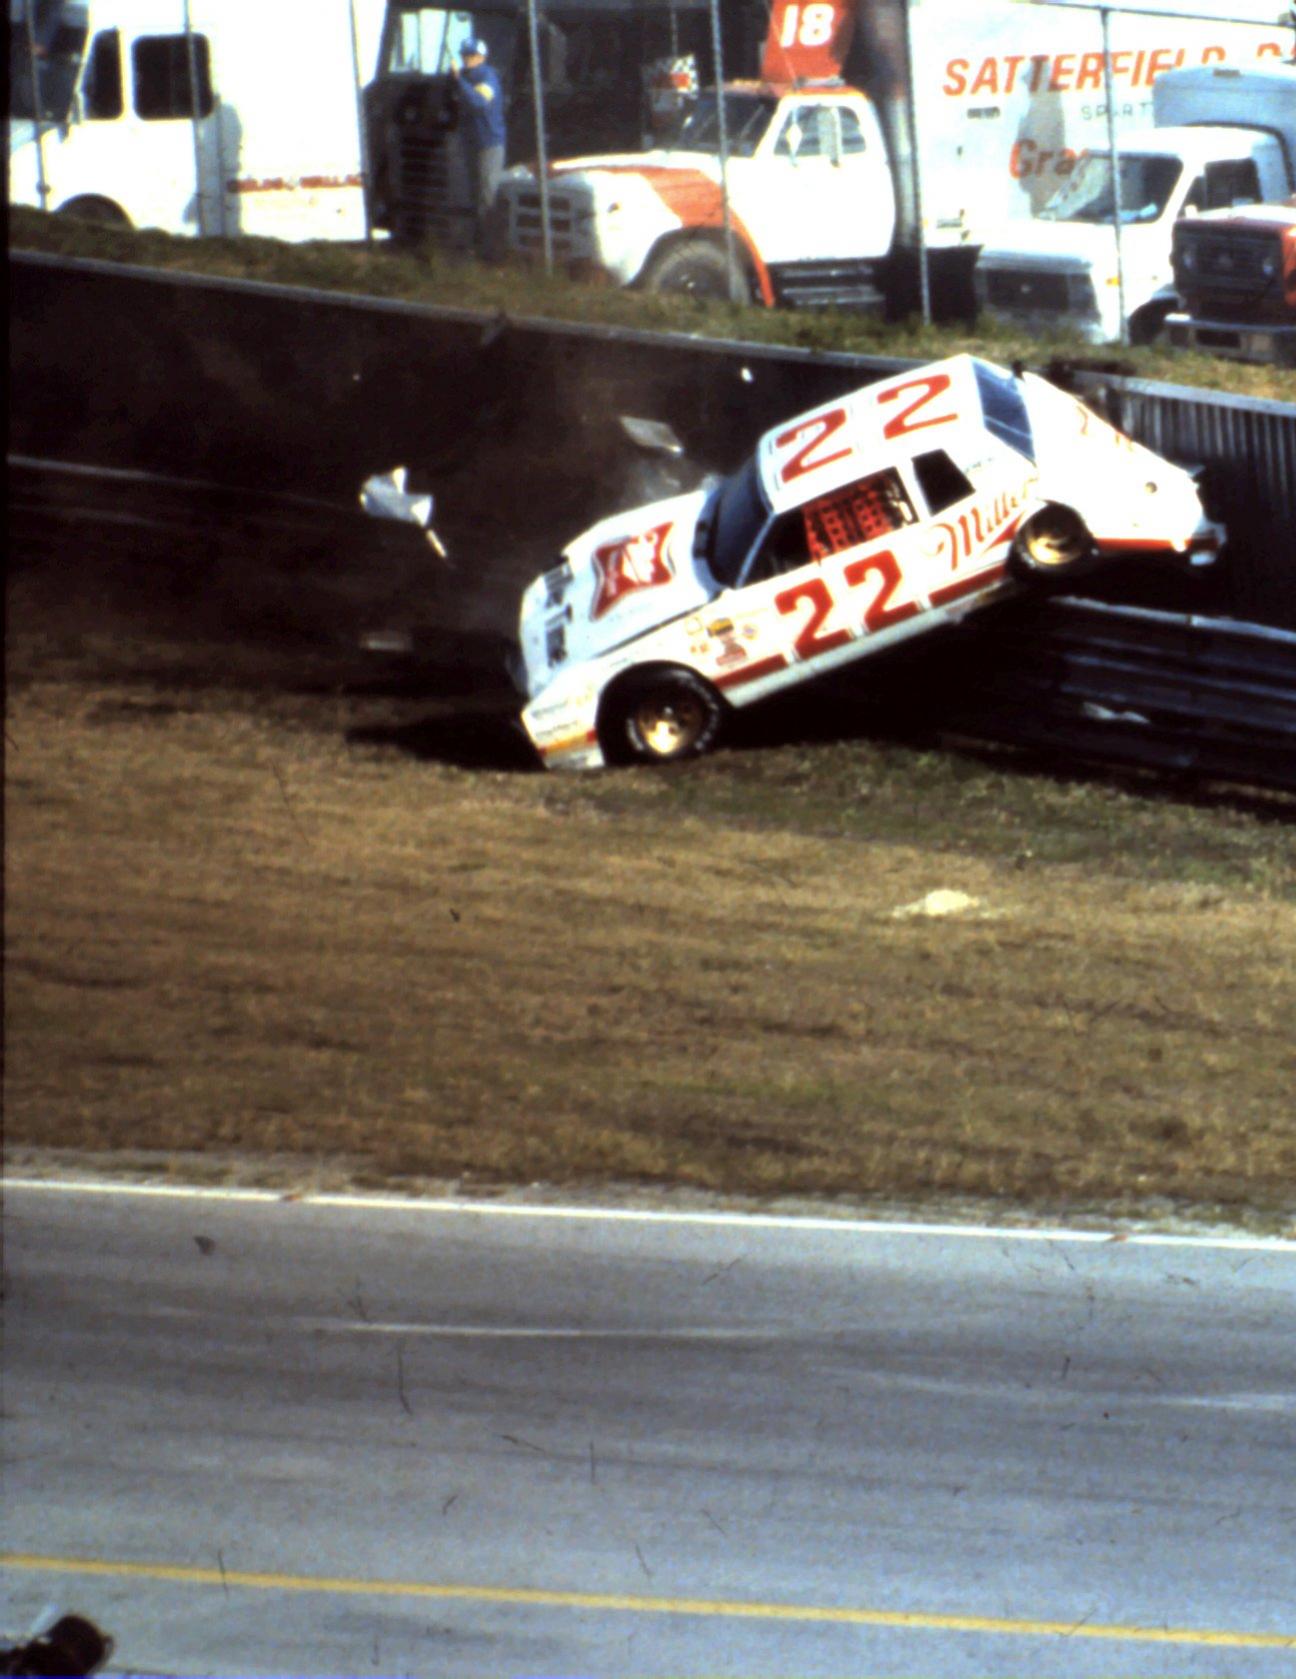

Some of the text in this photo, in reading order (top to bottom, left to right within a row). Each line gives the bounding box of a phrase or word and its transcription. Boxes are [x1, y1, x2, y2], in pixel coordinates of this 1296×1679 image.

[780, 3, 834, 47] 18
[775, 374, 958, 483] 22
[774, 549, 921, 661] 22
